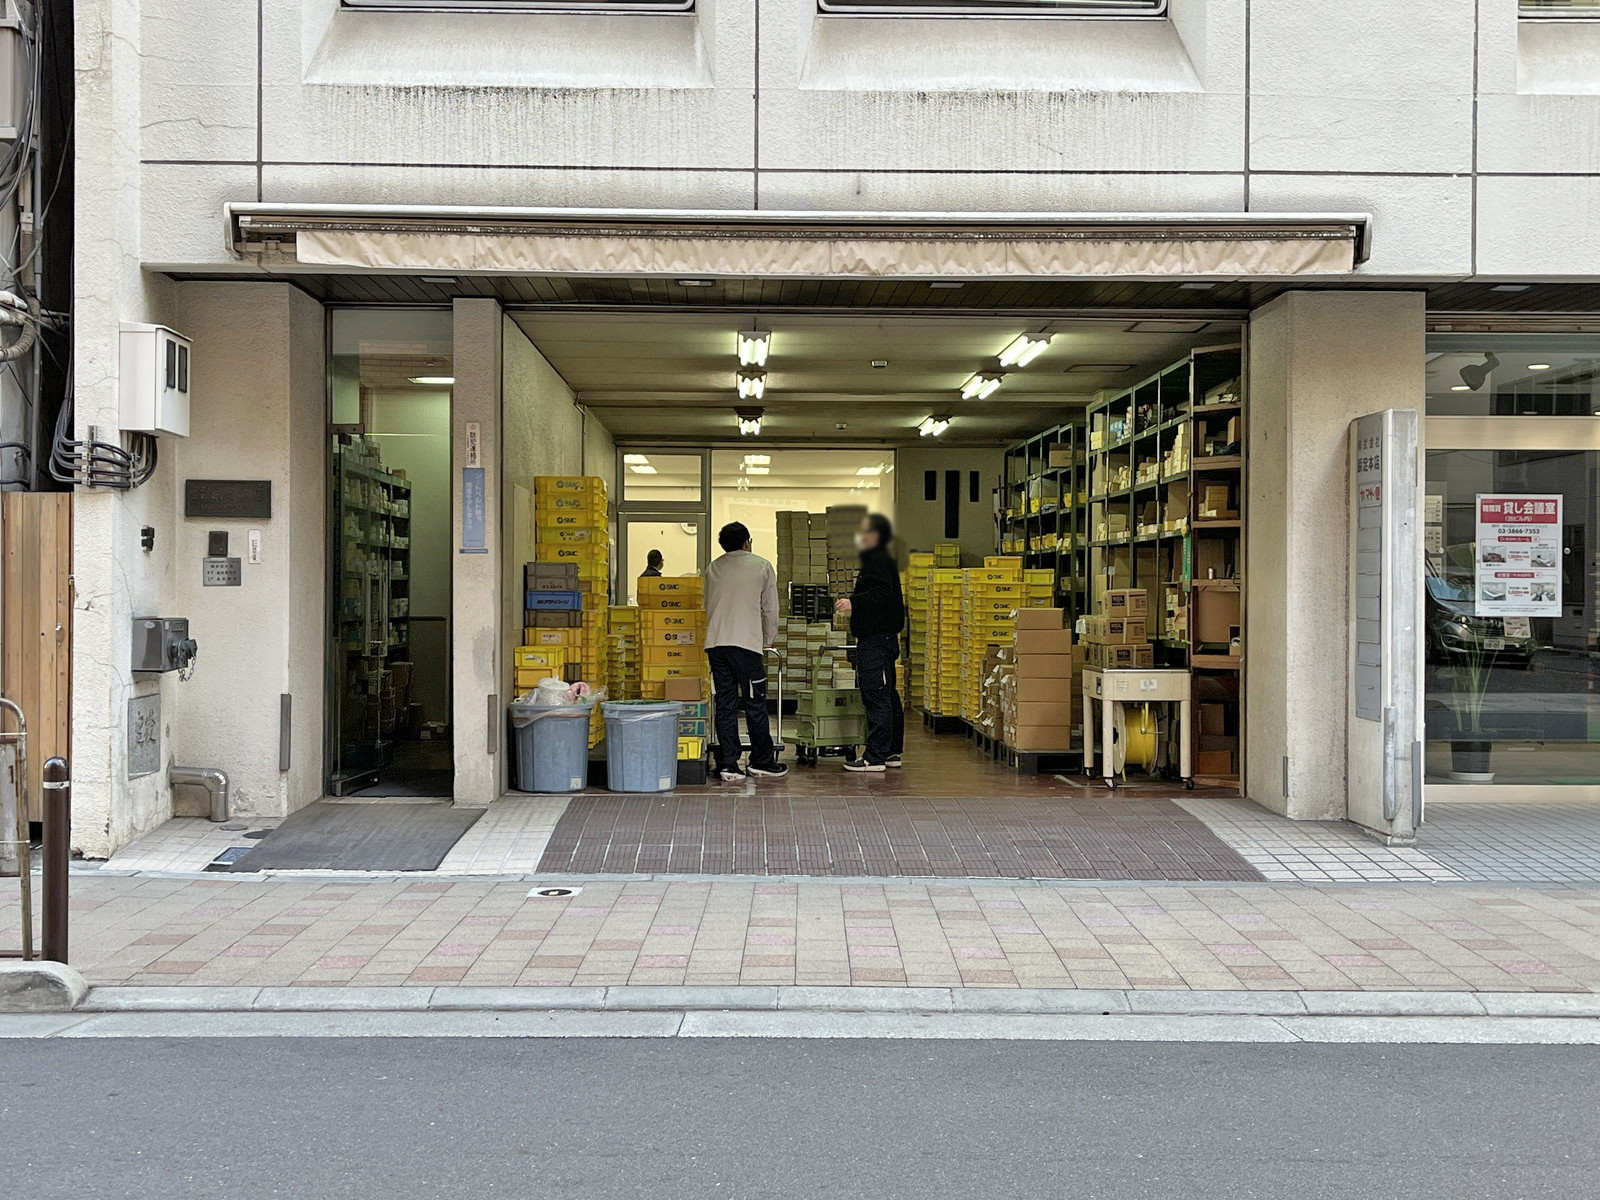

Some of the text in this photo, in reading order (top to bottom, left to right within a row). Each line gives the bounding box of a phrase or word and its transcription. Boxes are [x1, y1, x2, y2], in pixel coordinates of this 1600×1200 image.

[1503, 501, 1555, 514] 貸し会議室
